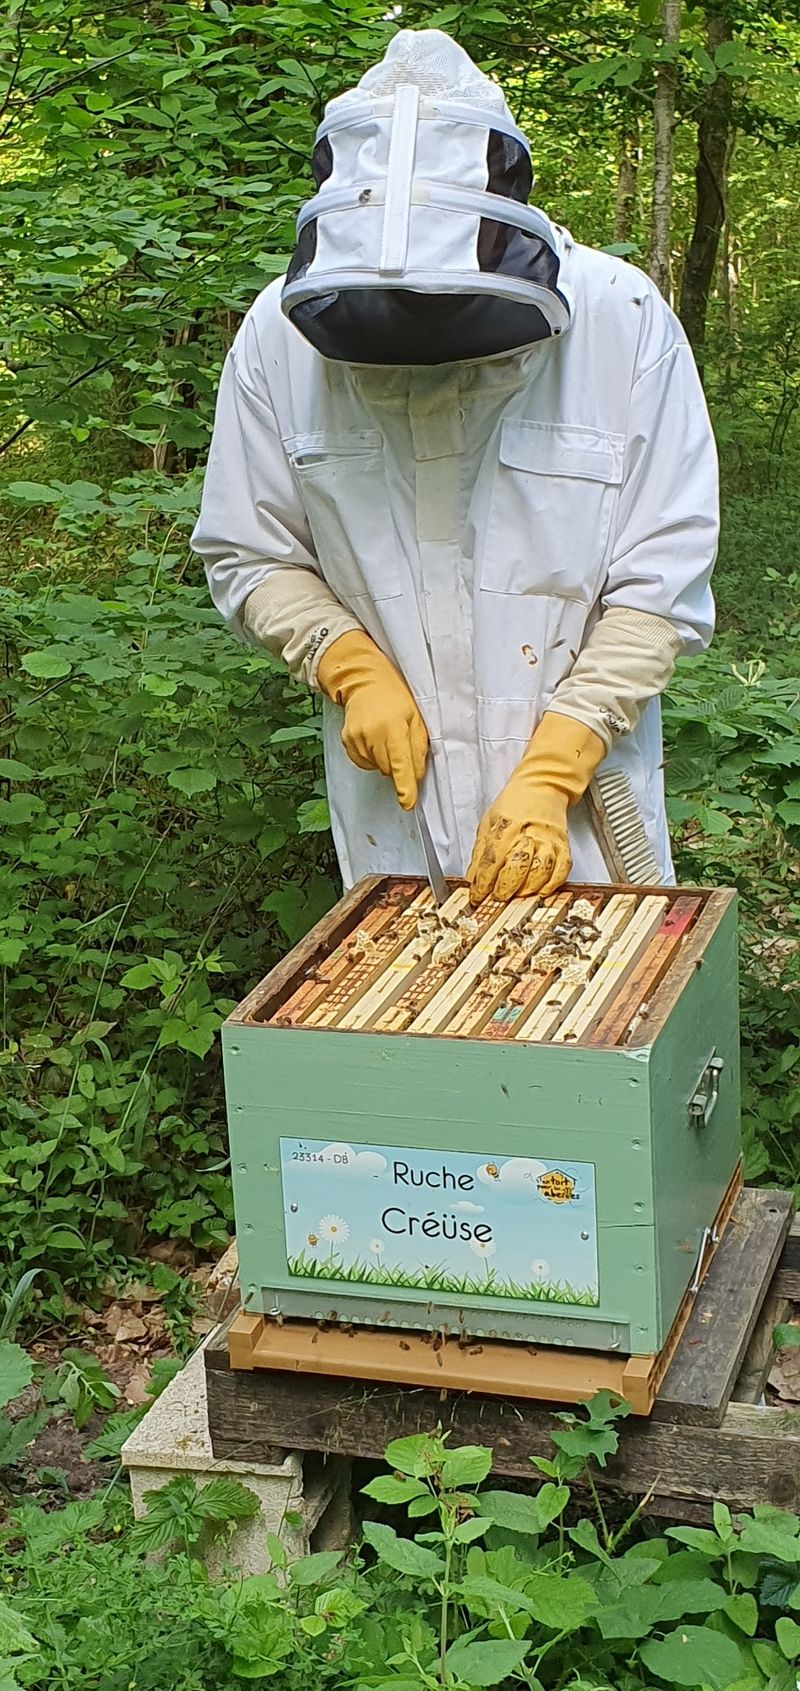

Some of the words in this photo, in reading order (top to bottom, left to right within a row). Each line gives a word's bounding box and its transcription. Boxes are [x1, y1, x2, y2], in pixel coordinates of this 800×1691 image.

[292, 1151, 324, 1163] 23314
[393, 1161, 474, 1191] Ruche
[381, 1207, 493, 1243] Créüse
